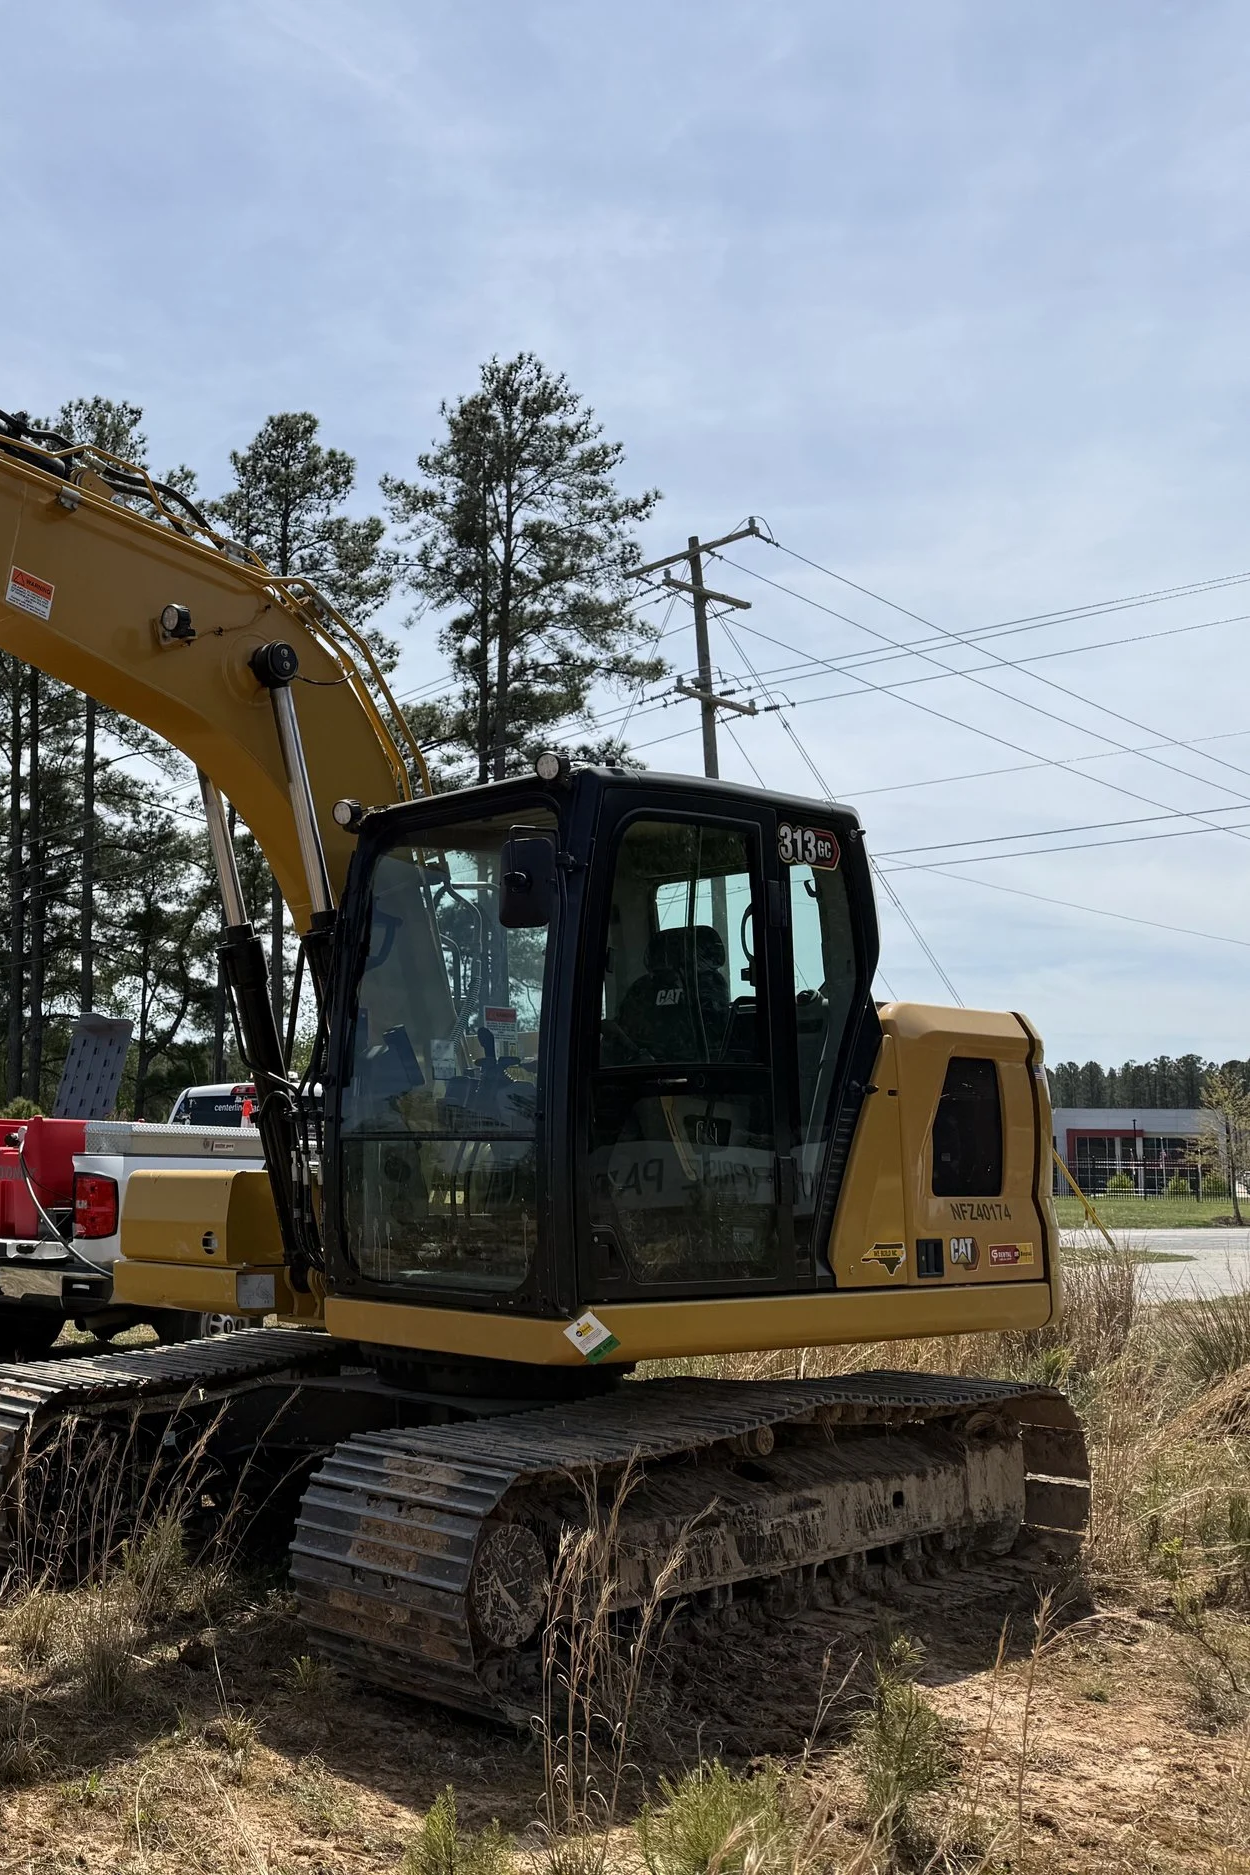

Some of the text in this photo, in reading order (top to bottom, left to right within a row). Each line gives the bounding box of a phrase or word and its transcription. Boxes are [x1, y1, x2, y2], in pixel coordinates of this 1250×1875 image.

[780, 825, 832, 863] 313 GC
[655, 988, 683, 1006] CAT
[950, 1203, 1012, 1221] NFZ40174
[950, 1238, 972, 1263] CAT
